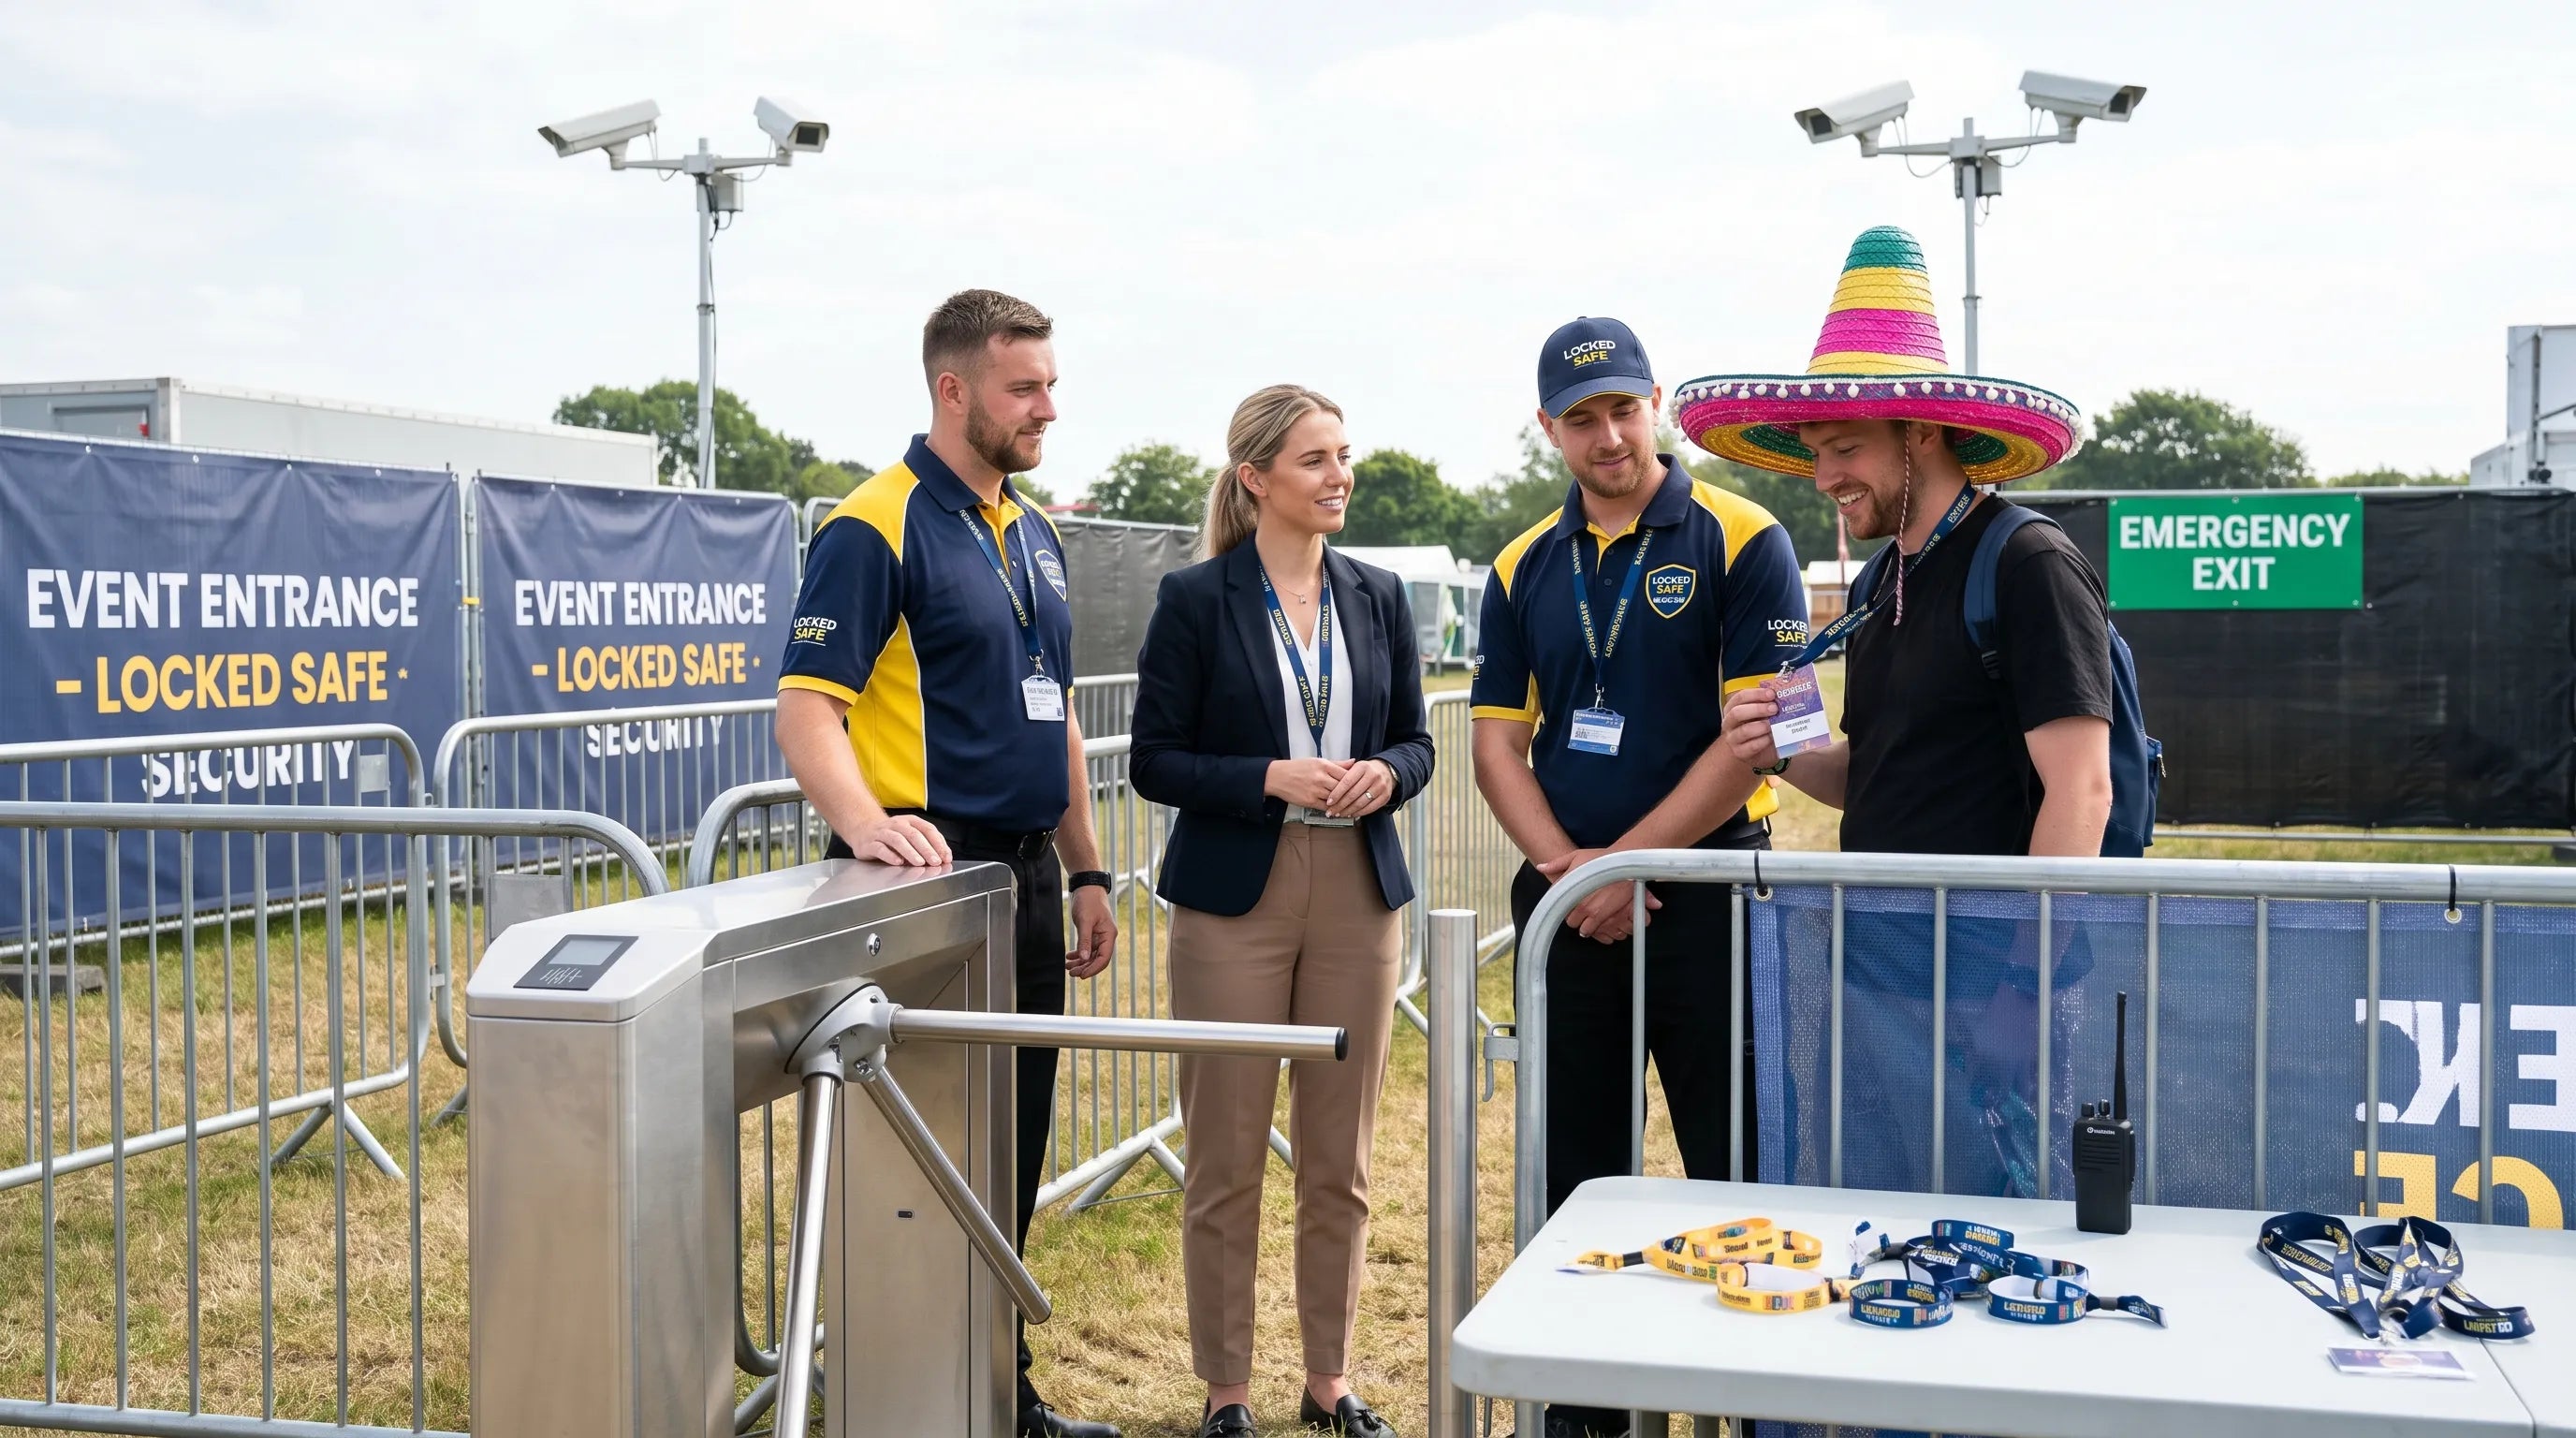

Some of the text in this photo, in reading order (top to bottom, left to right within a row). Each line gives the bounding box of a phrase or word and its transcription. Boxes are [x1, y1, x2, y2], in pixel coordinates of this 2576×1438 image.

[1563, 340, 1617, 360] LOCKED
[1573, 350, 1609, 367] SAFE
[2119, 513, 2351, 550] EMERGENCY
[1652, 576, 1690, 585] LOCKED
[2192, 556, 2276, 591] EXIT
[27, 568, 419, 629] EVENT ENTRANCE
[1656, 584, 1685, 594] SAFE
[515, 580, 767, 626] EVENT ENTRANCE
[793, 616, 838, 631] LOCKED
[794, 627, 827, 641] SAFE
[558, 644, 677, 692] LOCKED
[681, 642, 747, 686] SAFE
[96, 654, 282, 714] LOCKED
[291, 651, 388, 705] SAFE
